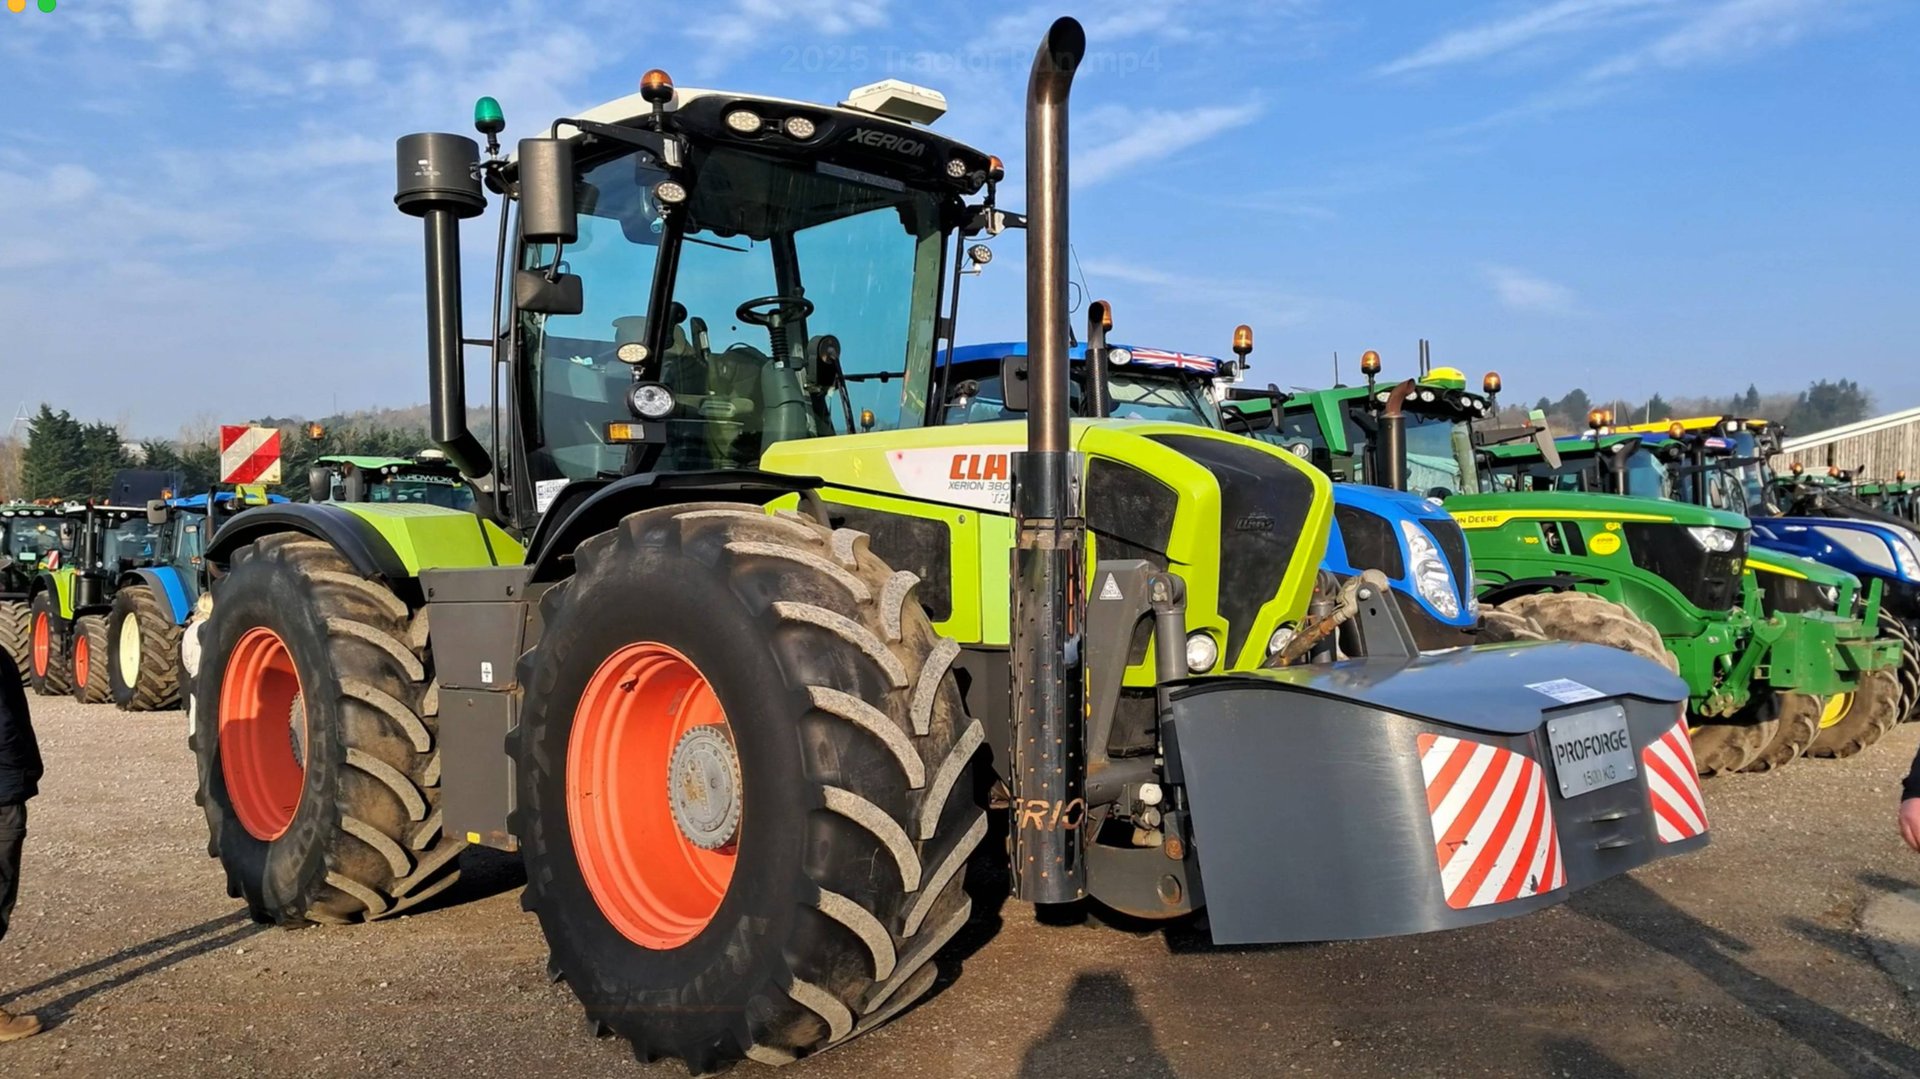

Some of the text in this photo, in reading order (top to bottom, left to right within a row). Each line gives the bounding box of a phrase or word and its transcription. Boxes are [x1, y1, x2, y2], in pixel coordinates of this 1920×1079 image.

[848, 127, 925, 156] XERION
[949, 454, 1007, 480] CLA
[948, 481, 1011, 491] XERION 380
[991, 491, 1010, 505] TR
[1468, 515, 1498, 523] DEERE
[1555, 729, 1628, 766] PROFORGE
[1604, 765, 1616, 780] KG
[1015, 798, 1085, 832] RIO
